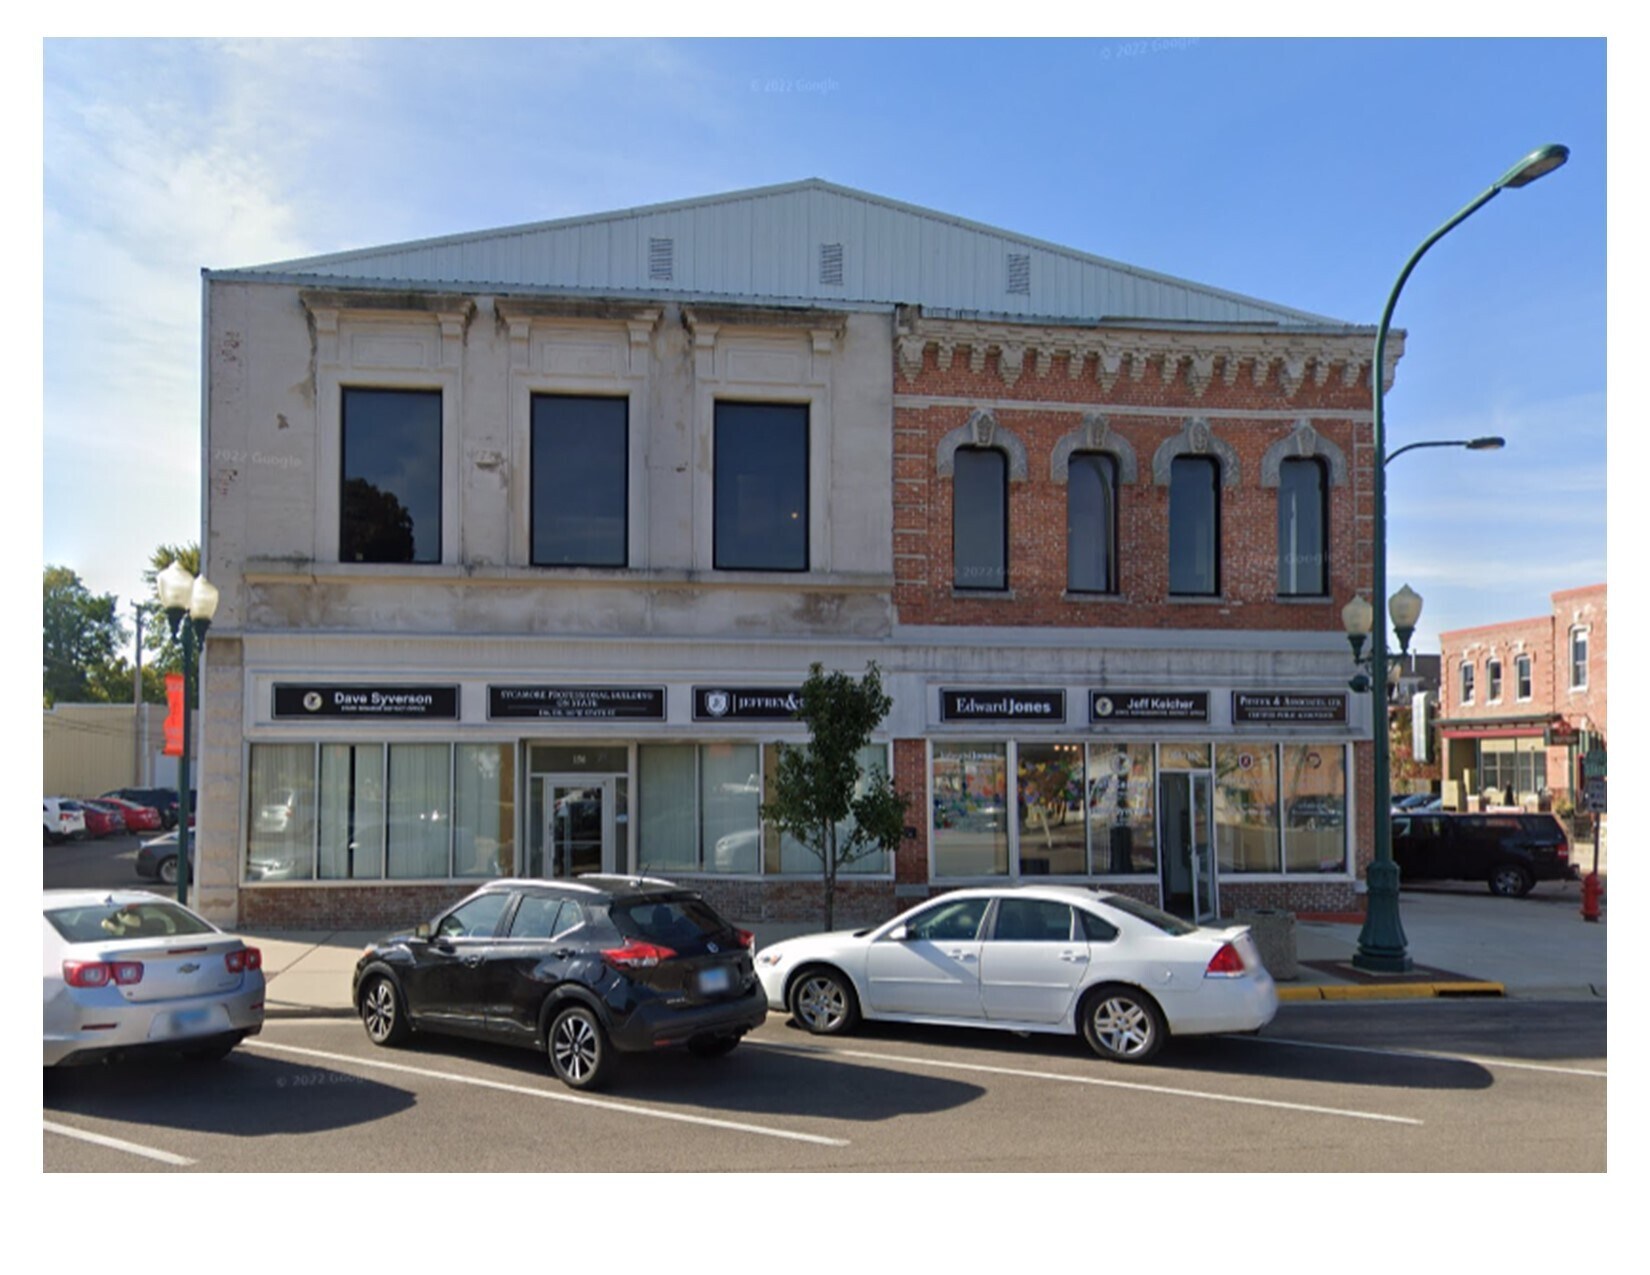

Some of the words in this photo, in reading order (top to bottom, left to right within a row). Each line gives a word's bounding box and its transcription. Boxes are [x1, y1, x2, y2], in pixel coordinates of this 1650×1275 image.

[334, 692, 367, 705] Dave
[371, 691, 432, 708] Syverson
[1127, 698, 1149, 710] Jeff
